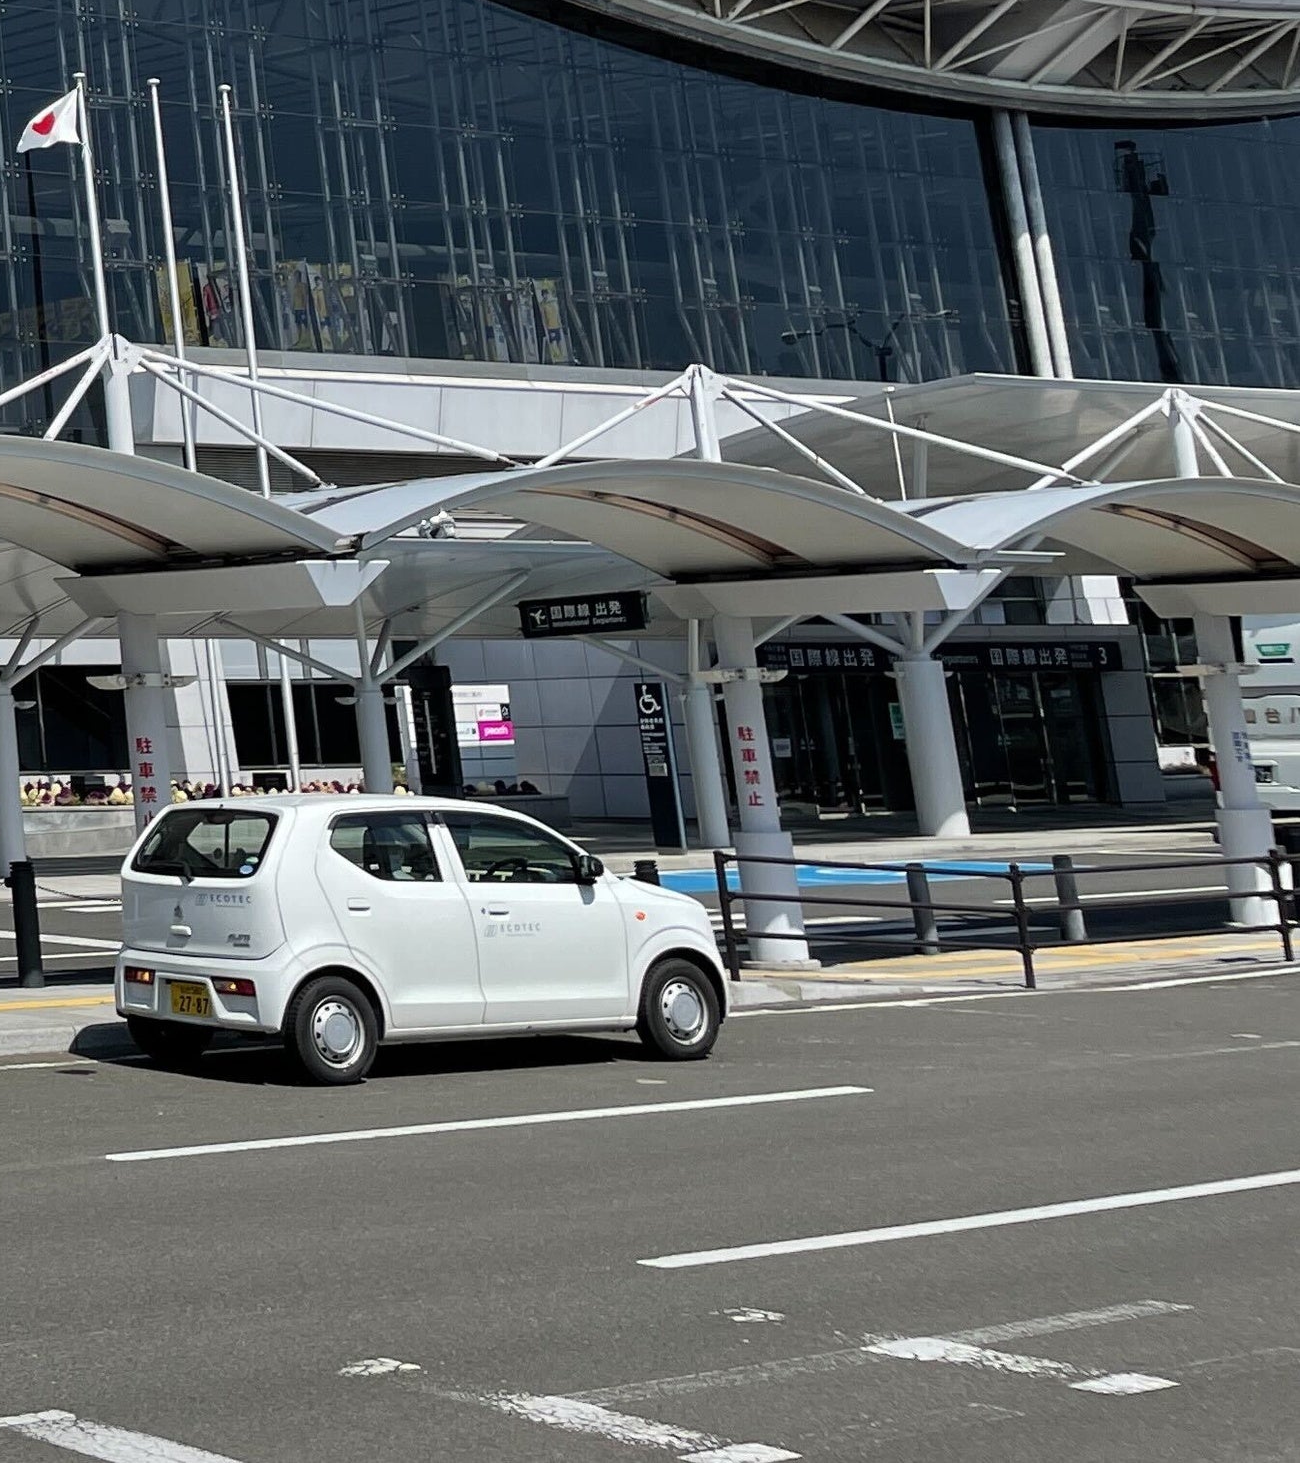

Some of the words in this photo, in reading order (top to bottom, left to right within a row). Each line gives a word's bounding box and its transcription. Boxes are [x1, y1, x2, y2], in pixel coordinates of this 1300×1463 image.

[1098, 646, 1108, 665] 3
[738, 726, 764, 807] 駐車禁止
[210, 893, 253, 904] ECOTEC
